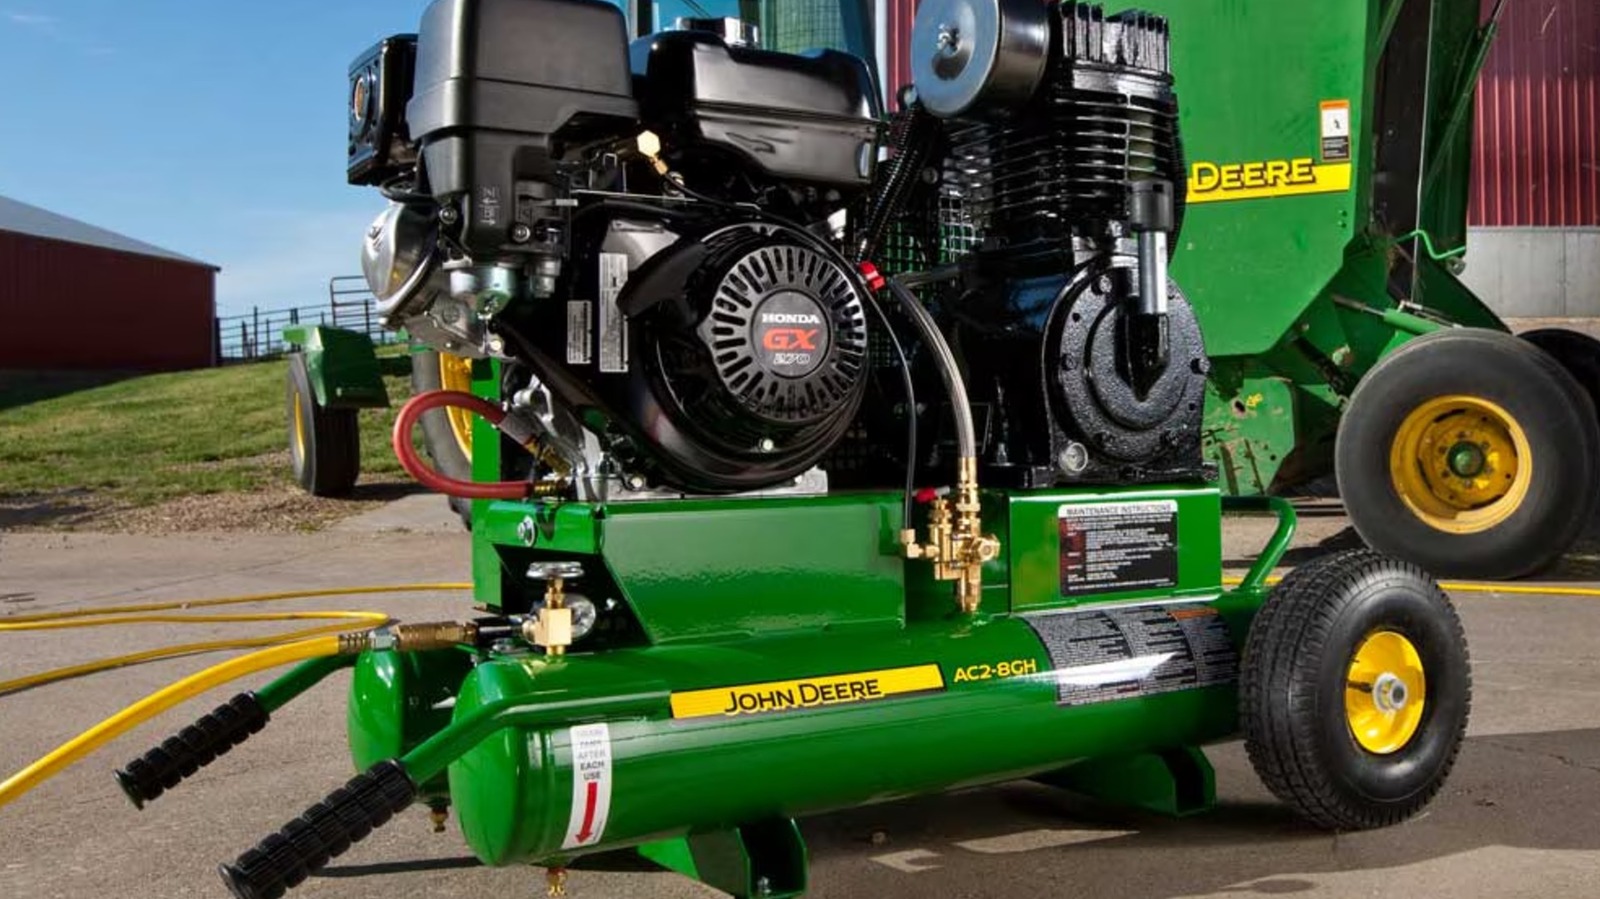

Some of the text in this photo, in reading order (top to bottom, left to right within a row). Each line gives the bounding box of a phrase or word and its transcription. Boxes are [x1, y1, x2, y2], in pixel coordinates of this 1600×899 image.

[1191, 157, 1316, 192] DEERE
[762, 313, 820, 324] HONDA
[763, 328, 818, 350] GX
[1066, 503, 1172, 515] MAINTENANCE INSTRUCTIONS
[953, 658, 1037, 683] AC2-8GH
[724, 679, 881, 713] JOHN DEERE
[580, 760, 604, 771] EACH
[583, 771, 601, 781] USE
